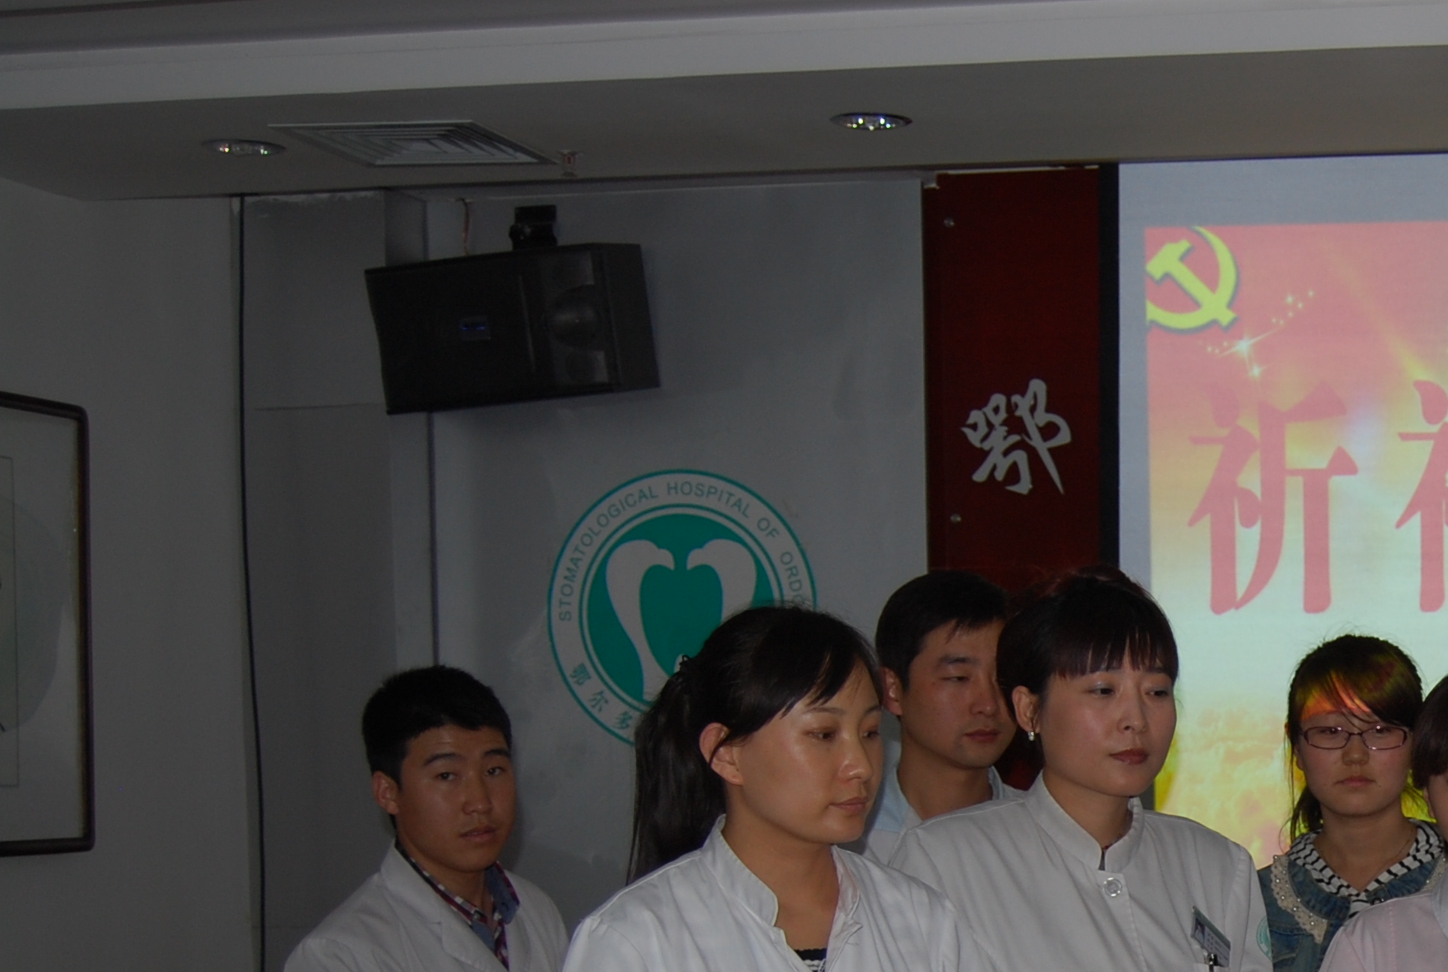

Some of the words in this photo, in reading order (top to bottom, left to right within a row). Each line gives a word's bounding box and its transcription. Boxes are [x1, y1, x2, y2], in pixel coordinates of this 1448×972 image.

[960, 378, 1072, 496] 鄂
[558, 484, 659, 622] STOMATOLOGICAL
[666, 481, 753, 519] HOSPITAL
[757, 517, 779, 540] OF
